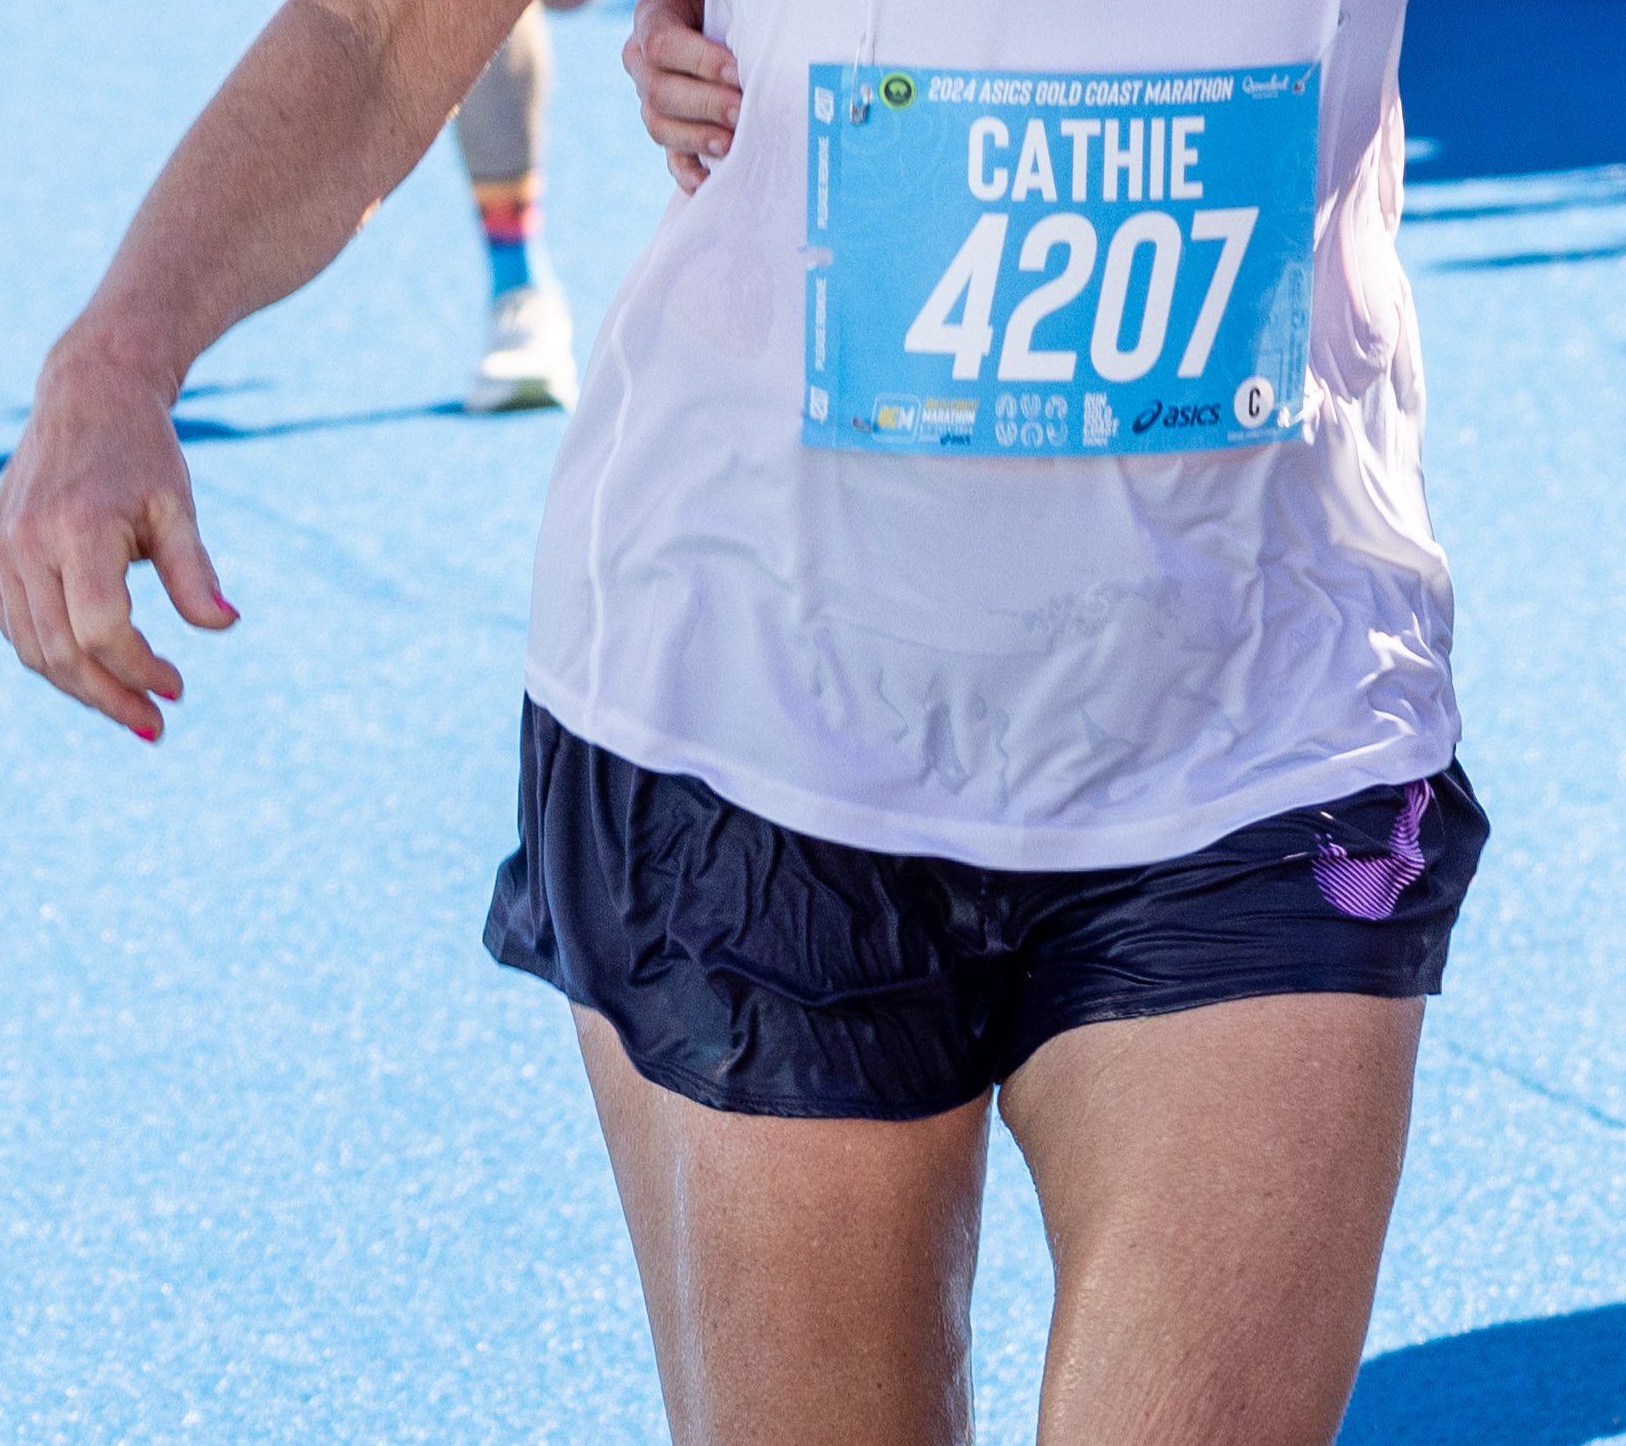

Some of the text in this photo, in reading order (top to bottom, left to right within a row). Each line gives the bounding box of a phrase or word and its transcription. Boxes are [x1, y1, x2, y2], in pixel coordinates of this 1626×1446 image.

[927, 76, 976, 103] 2024
[979, 78, 1032, 105] ASICS
[1035, 79, 1081, 106] GOLD
[1085, 78, 1141, 106] COAST
[1144, 76, 1234, 105] MARATHON
[967, 115, 1206, 202] CATHIE
[904, 206, 1260, 383] 4207
[1163, 403, 1222, 428] asics
[1248, 387, 1261, 418] C
